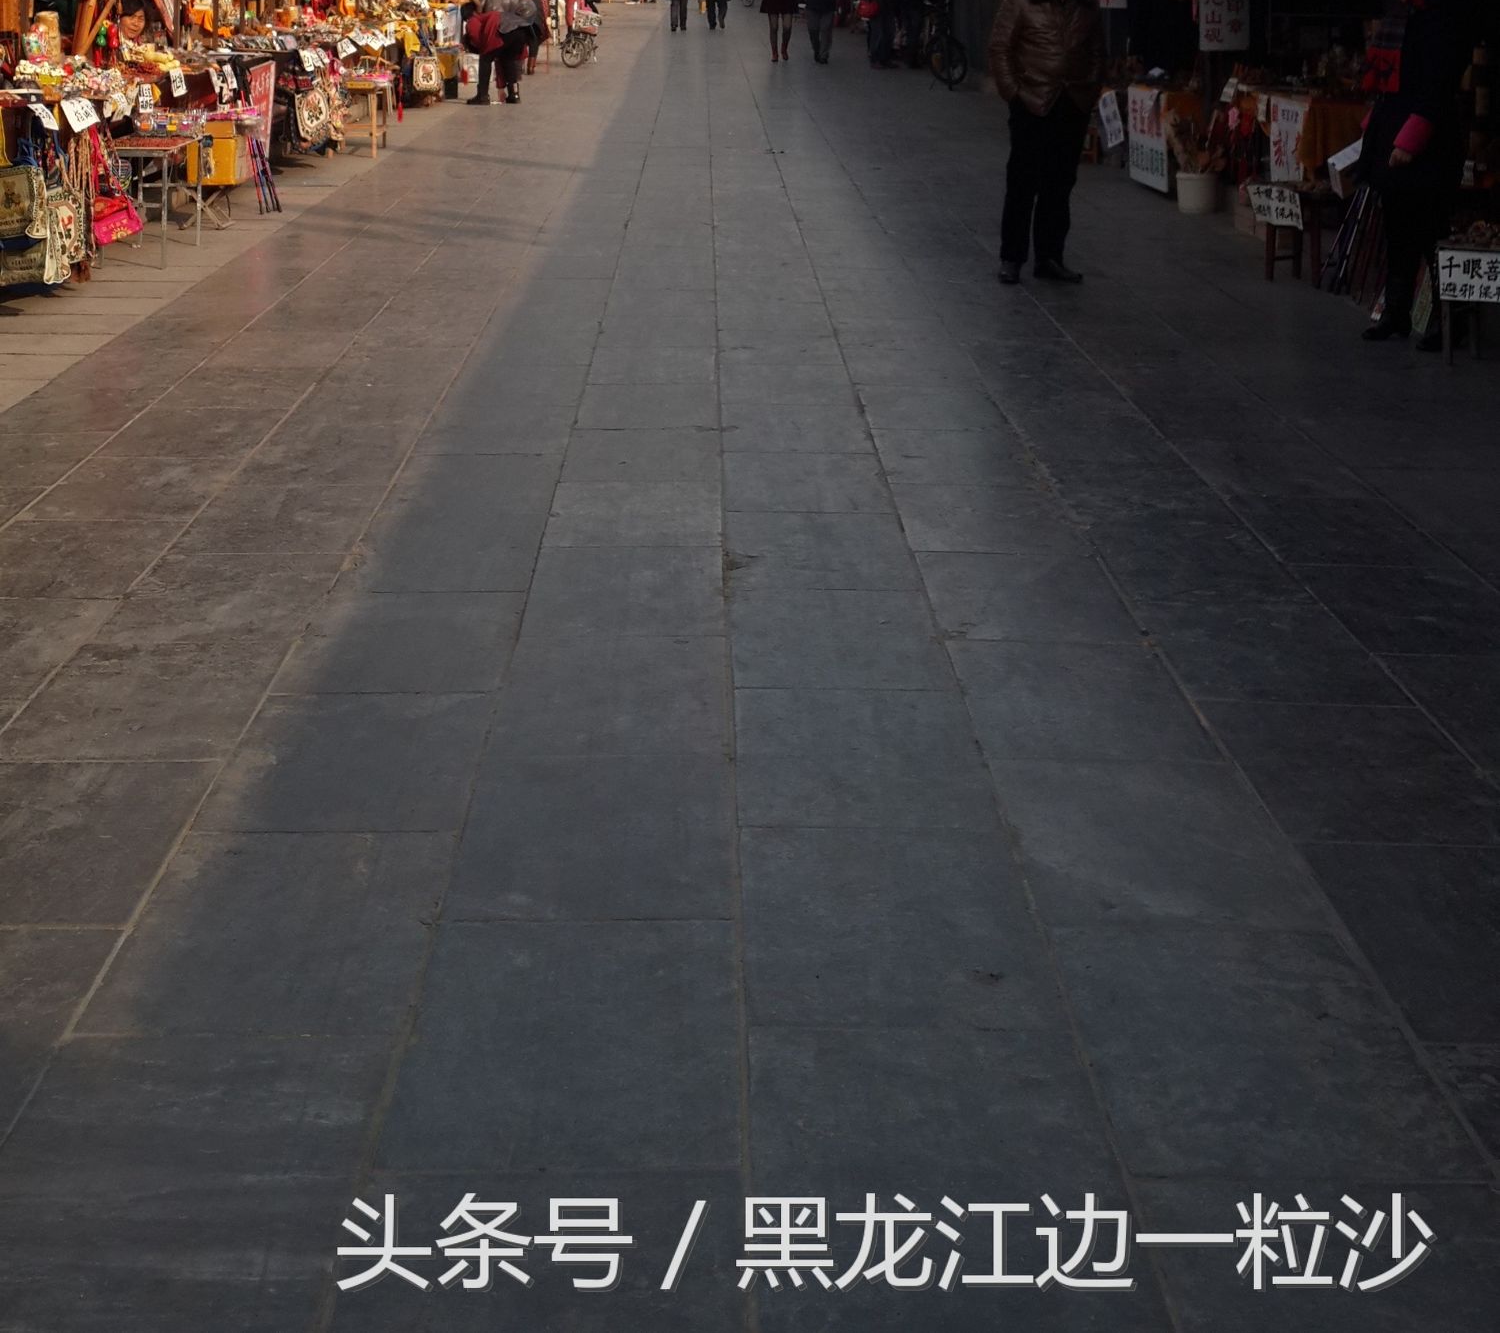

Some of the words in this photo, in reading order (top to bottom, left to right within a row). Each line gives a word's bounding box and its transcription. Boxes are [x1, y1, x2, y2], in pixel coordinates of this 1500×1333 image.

[1226, 0, 1244, 34] 印章
[1442, 256, 1500, 281] 千眼菩
